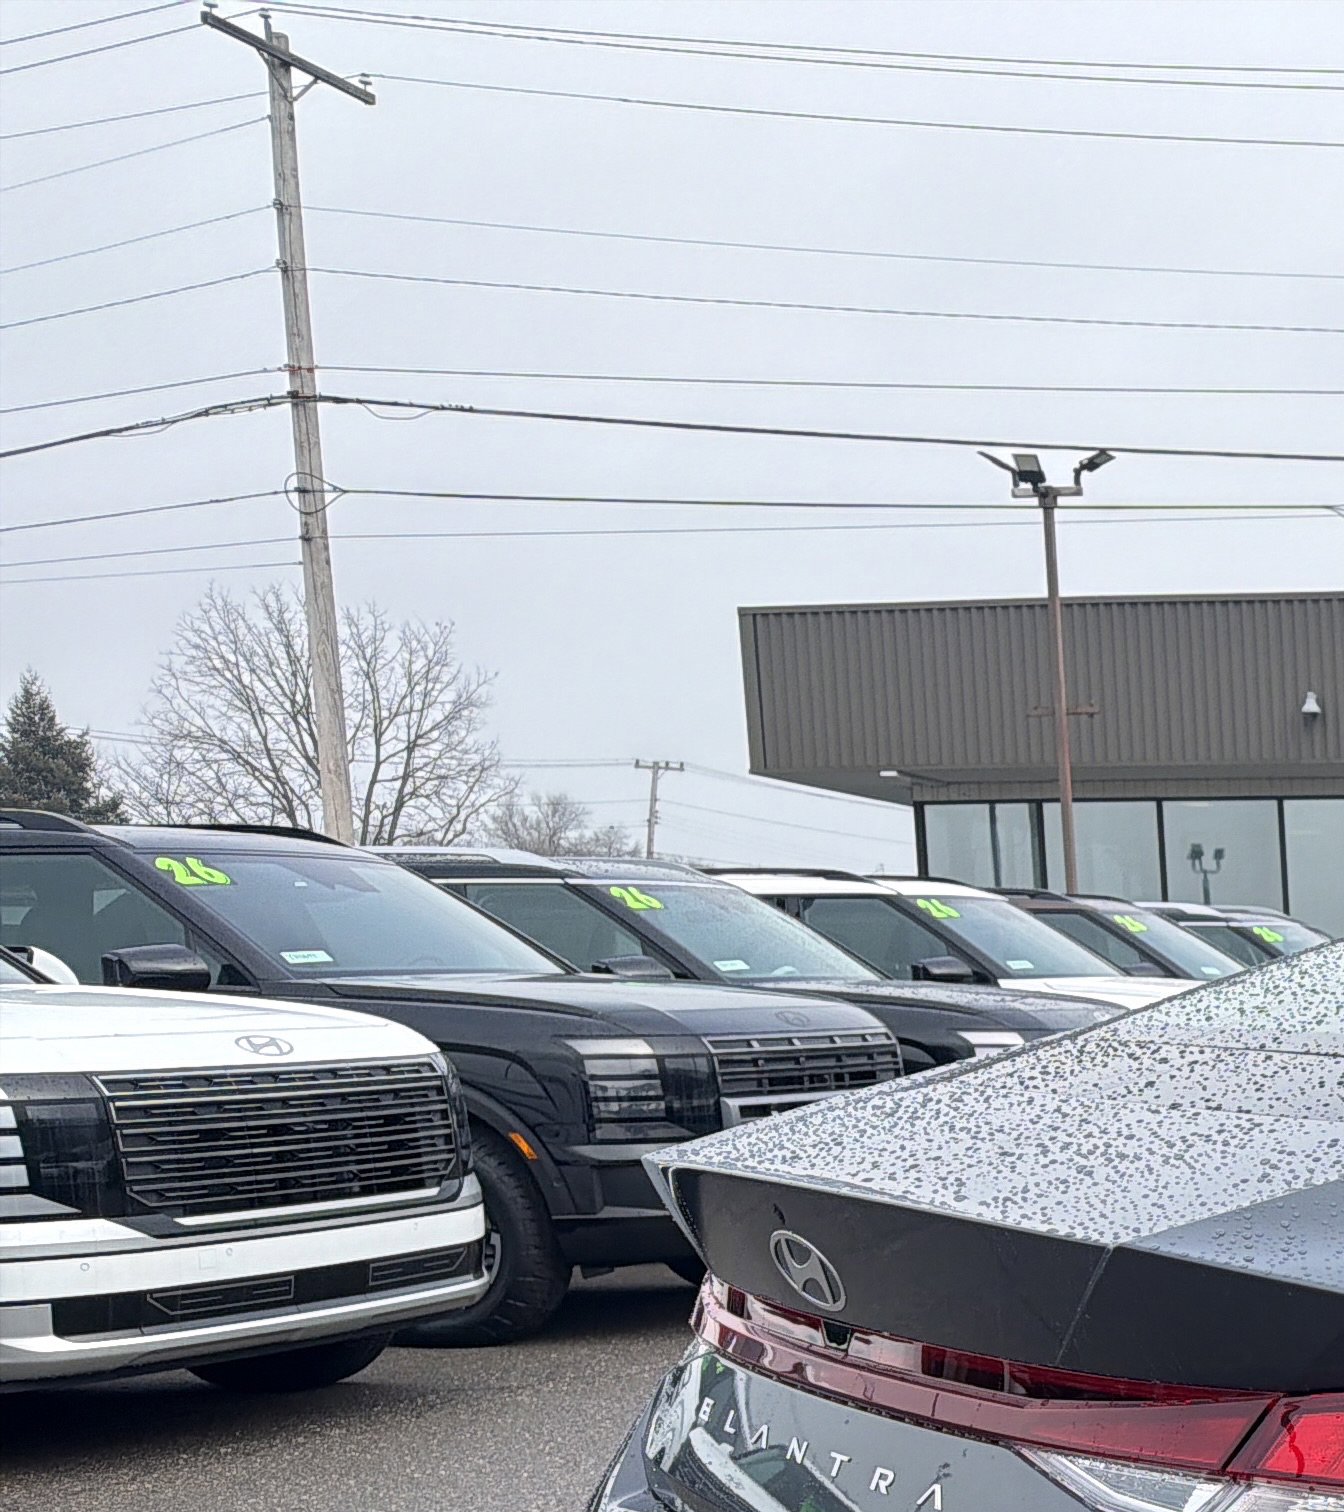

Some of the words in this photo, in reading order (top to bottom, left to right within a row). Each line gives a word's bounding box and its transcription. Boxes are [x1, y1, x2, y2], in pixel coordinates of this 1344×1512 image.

[154, 856, 231, 886] 26
[609, 886, 664, 910] 26
[698, 1396, 943, 1512] ELANTRA
